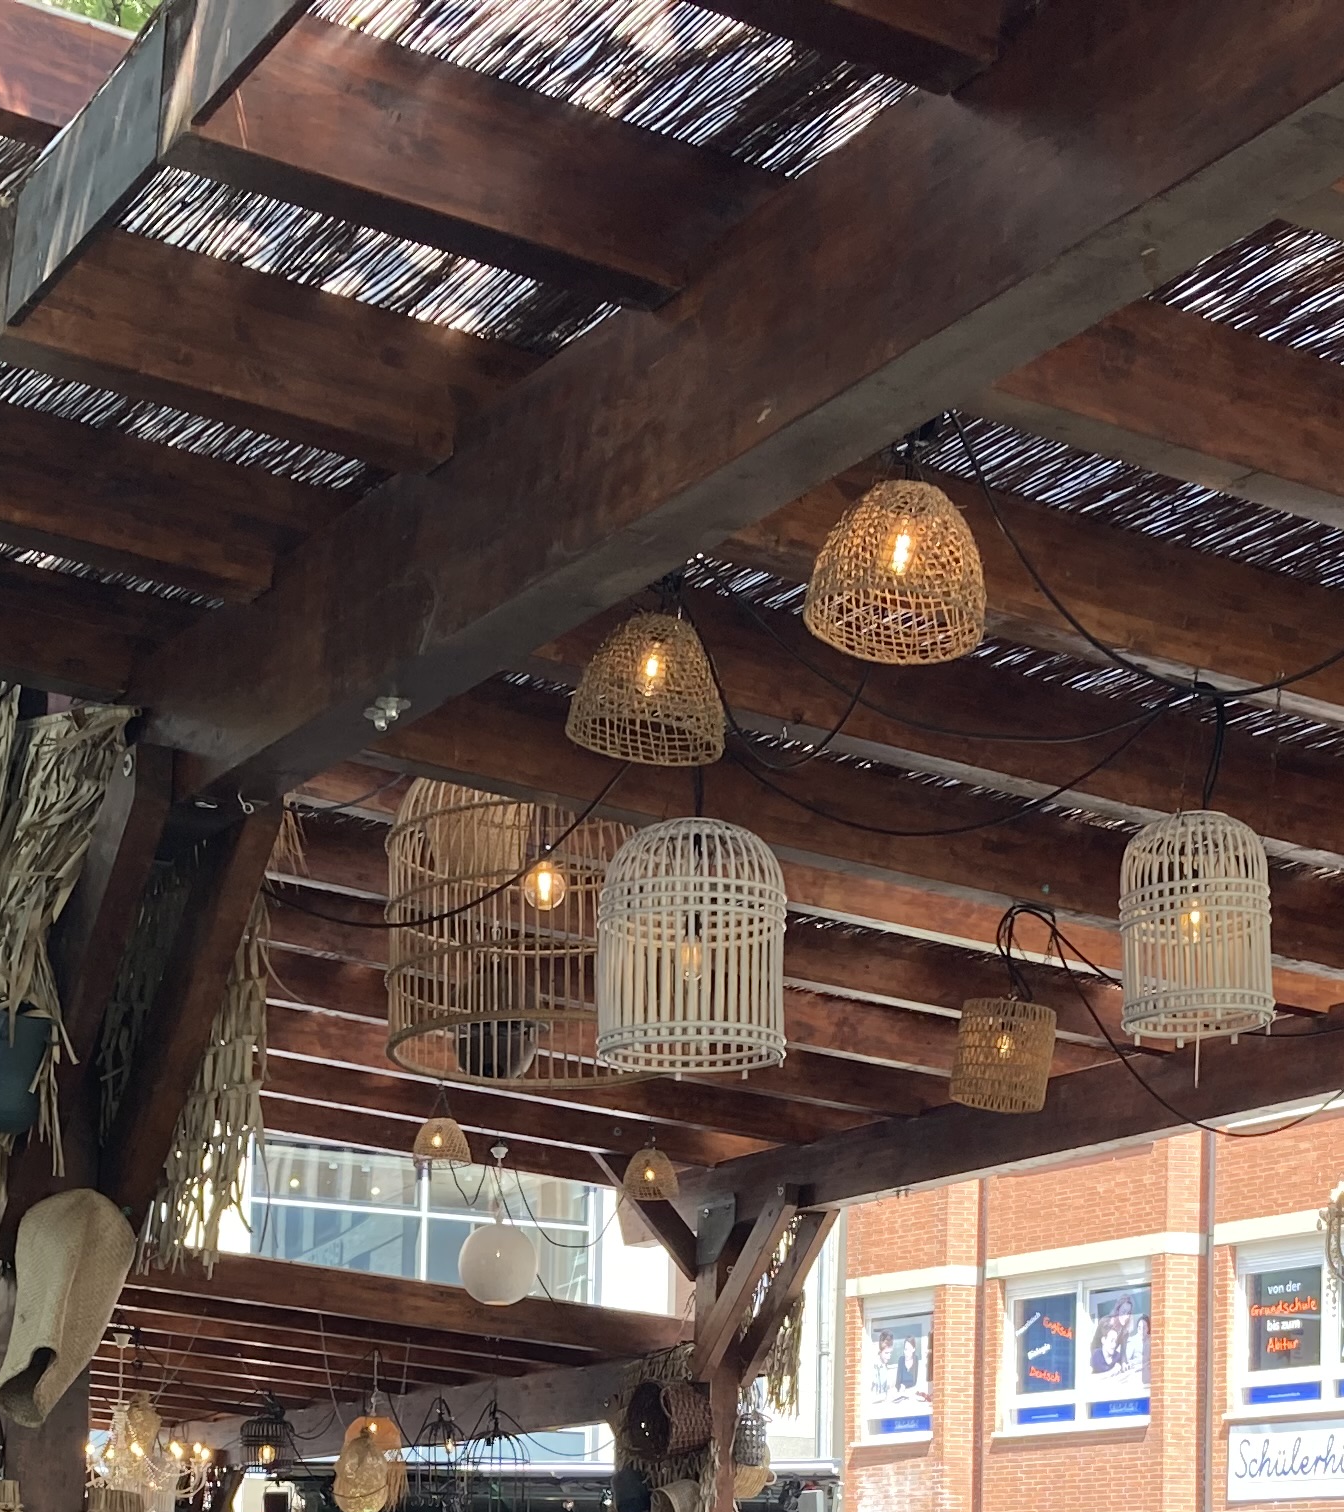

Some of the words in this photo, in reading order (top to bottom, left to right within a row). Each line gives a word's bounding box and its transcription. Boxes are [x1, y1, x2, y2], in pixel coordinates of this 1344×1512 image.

[1268, 1284, 1285, 1295] von
[1286, 1281, 1301, 1293] der
[1250, 1296, 1318, 1317] Grundschule
[1043, 1317, 1073, 1340] Englisch
[1267, 1320, 1280, 1332] bis
[1281, 1319, 1301, 1330] zum
[1267, 1337, 1299, 1353] Abitur
[1029, 1366, 1062, 1383] Deutsch
